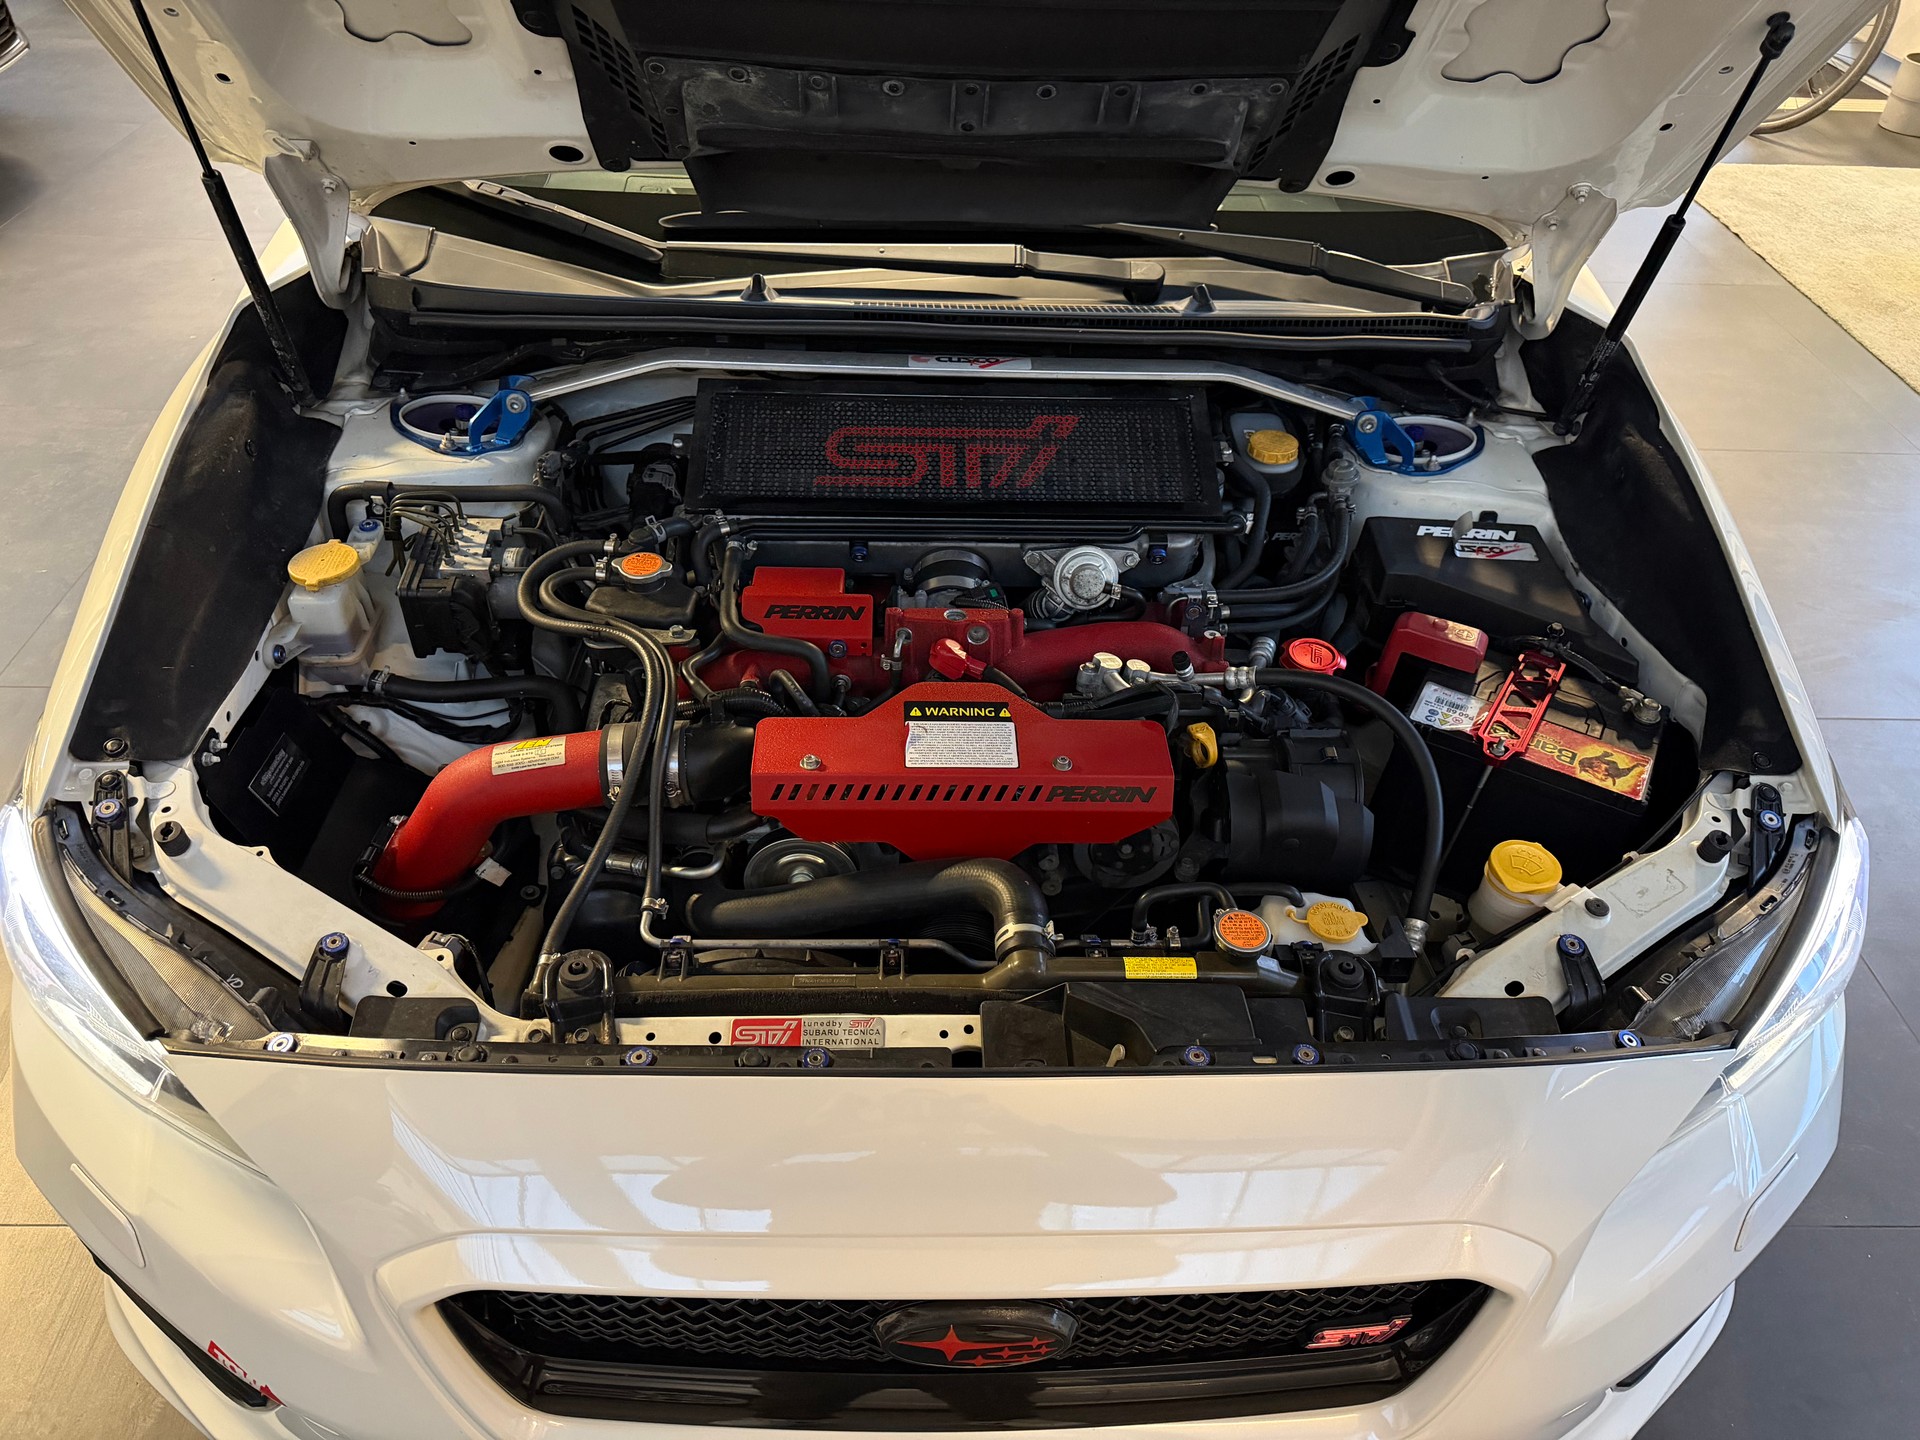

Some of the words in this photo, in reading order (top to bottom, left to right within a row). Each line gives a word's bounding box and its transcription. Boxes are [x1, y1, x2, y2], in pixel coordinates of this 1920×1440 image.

[1416, 525, 1517, 541] PERIN
[763, 605, 866, 620] PERRIN
[925, 707, 995, 717] WARNING
[1045, 786, 1157, 803] PERRIN
